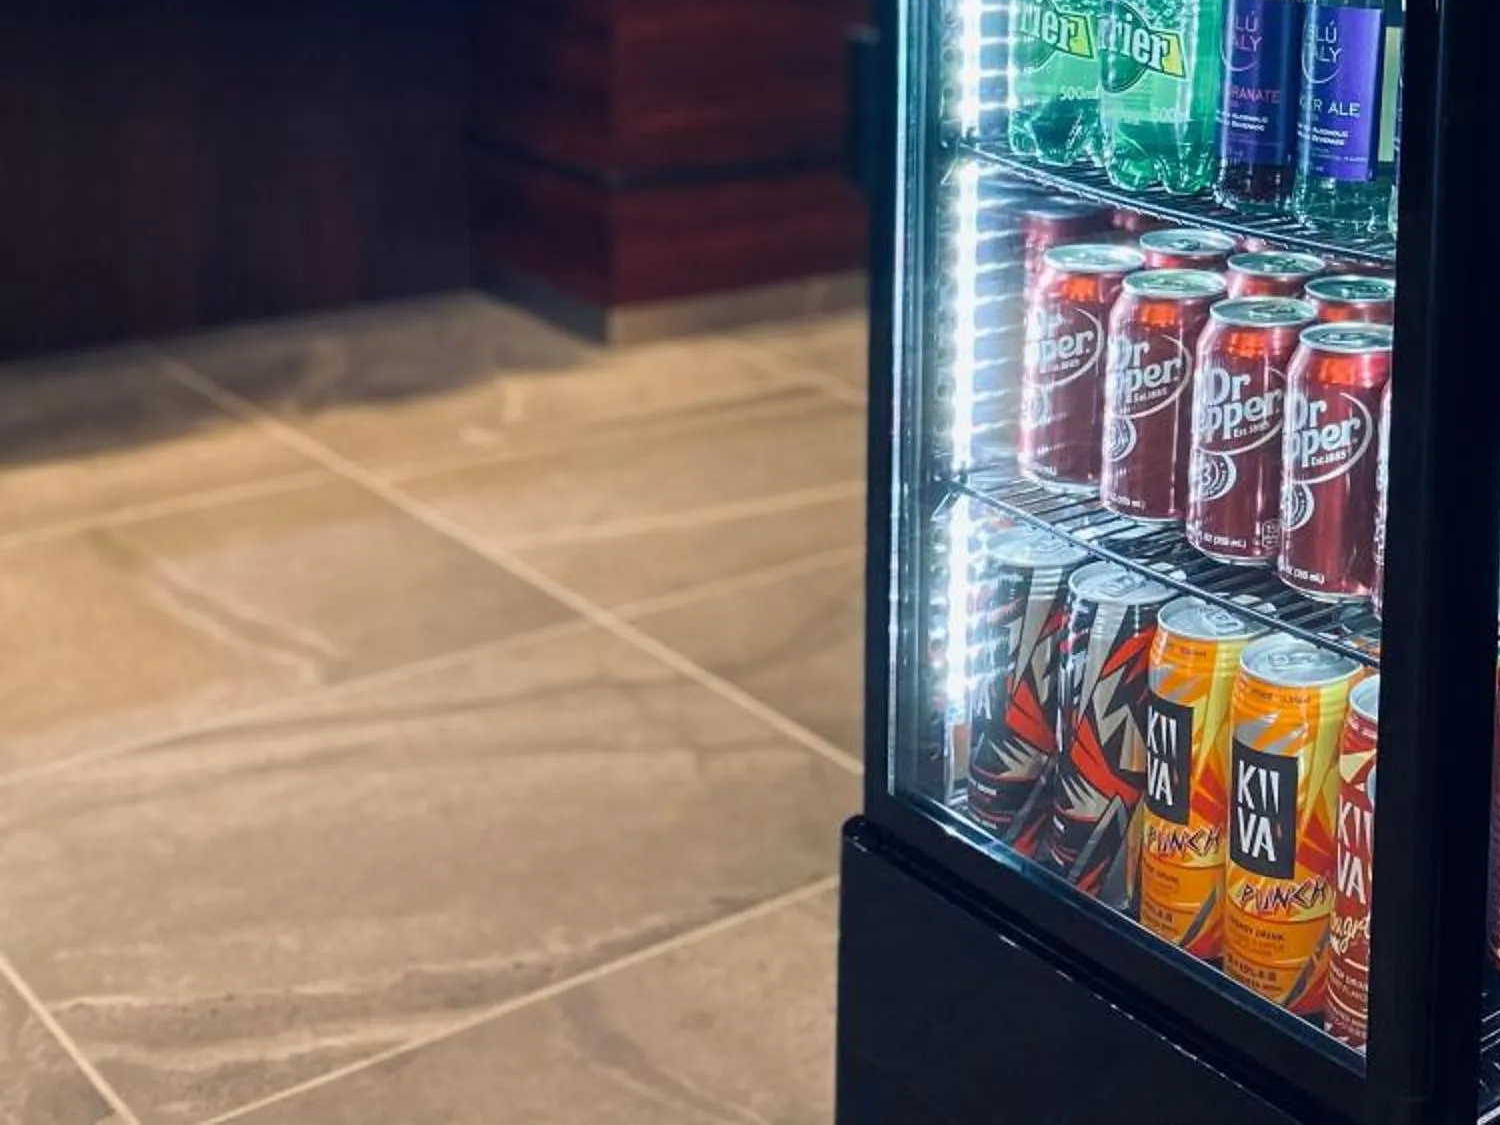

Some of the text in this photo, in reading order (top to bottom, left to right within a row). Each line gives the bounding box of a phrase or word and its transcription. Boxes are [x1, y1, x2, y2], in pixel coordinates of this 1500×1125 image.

[1328, 102, 1361, 118] ALE
[1207, 366, 1251, 406] Dr
[1236, 806, 1277, 862] VA
[1240, 875, 1327, 913] PUNCH
